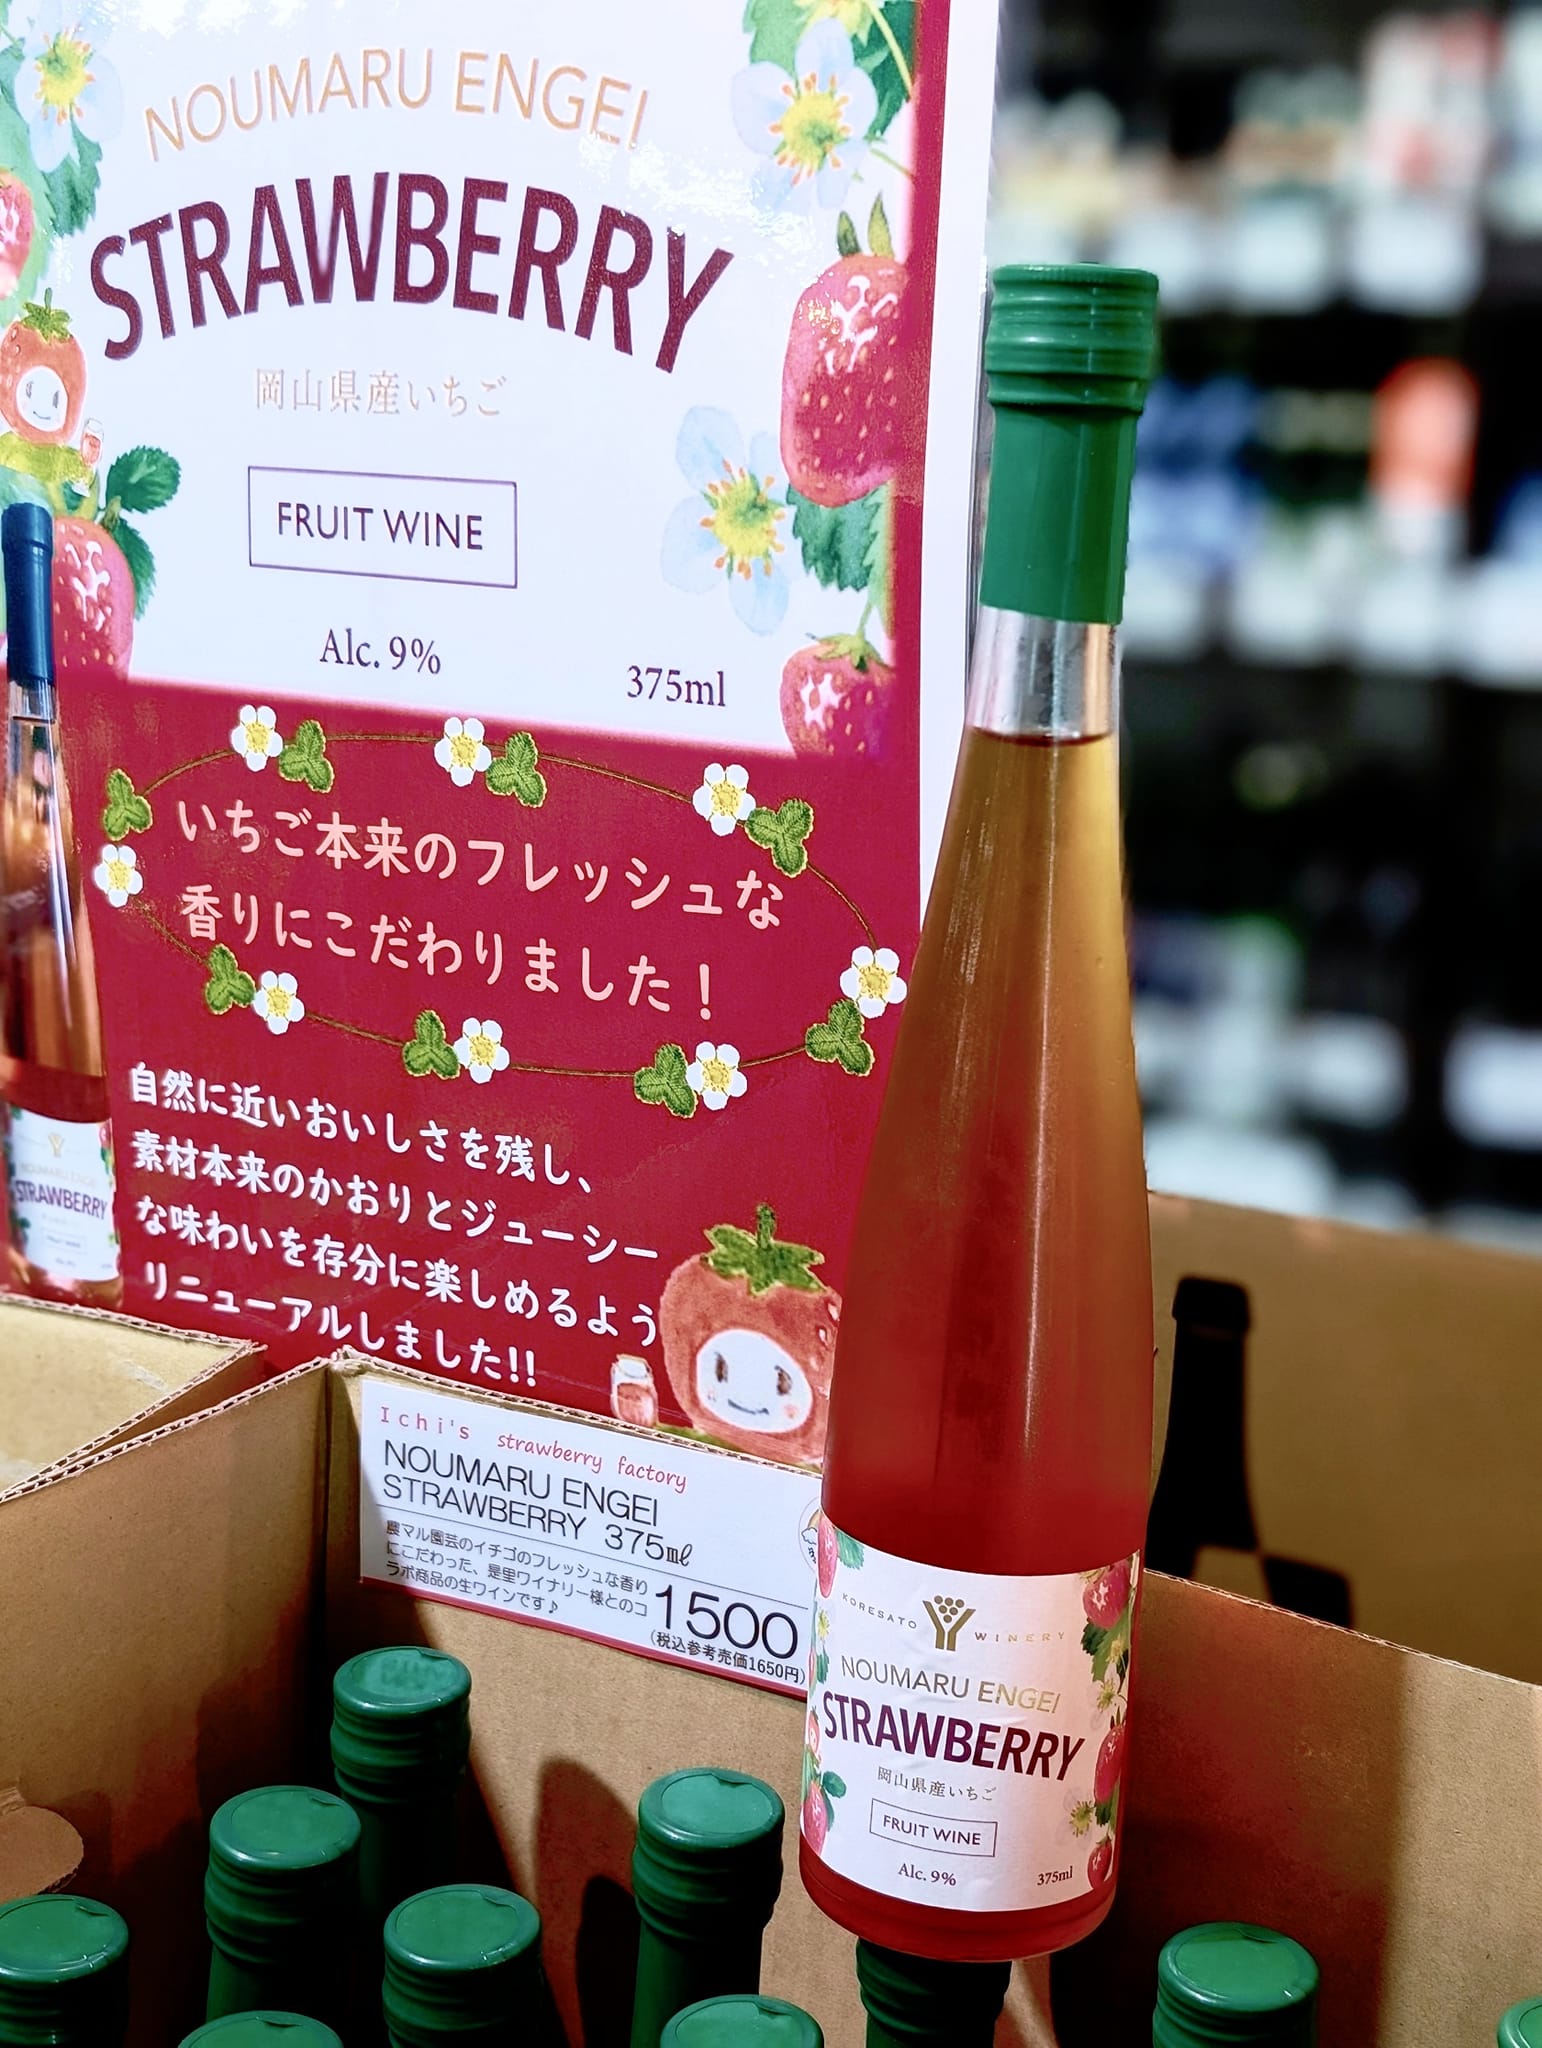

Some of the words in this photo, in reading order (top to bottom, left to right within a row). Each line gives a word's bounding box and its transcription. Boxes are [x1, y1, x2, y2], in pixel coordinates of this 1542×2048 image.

[145, 48, 434, 161] NOUMARU
[455, 51, 650, 150] ENGEI
[90, 172, 734, 374] STRAWBERRY
[255, 368, 508, 416] 岡山県産いちご
[277, 501, 374, 541] FRUIT
[384, 508, 483, 550] WINE
[320, 628, 379, 668] Alc.
[389, 636, 442, 674] 9%
[626, 665, 726, 707] 375ml
[178, 800, 784, 930] いちご本来のフレッシュな
[129, 1062, 592, 1193] 自然に近いおいしさを残し、
[15, 1180, 107, 1220] STRAWBERRY
[131, 1129, 659, 1265] 素材本来のかおりとジューシー
[137, 1195, 657, 1347] な味わいを存分に楽しめるよう
[384, 1440, 551, 1499] NOUMARU
[563, 1479, 658, 1526] ENGEI
[497, 1432, 602, 1474] strawberry
[617, 1456, 687, 1493] factory
[383, 1475, 587, 1540] STRAWBERRY
[656, 1584, 798, 1659] 1500
[842, 1593, 917, 1629] KORESATO
[974, 1631, 1065, 1644] WINERY
[841, 1655, 969, 1698] NOUMARU
[977, 1680, 1060, 1714] ENGEI
[824, 1691, 1086, 1781] STRAWBERRY
[877, 1766, 998, 1801] 岡山県産いちご
[882, 1814, 929, 1838] FRUIT
[932, 1825, 982, 1846] WINE
[897, 1864, 927, 1882] Alc.
[930, 1868, 957, 1886] 9%
[1036, 1866, 1074, 1886] 375ml
